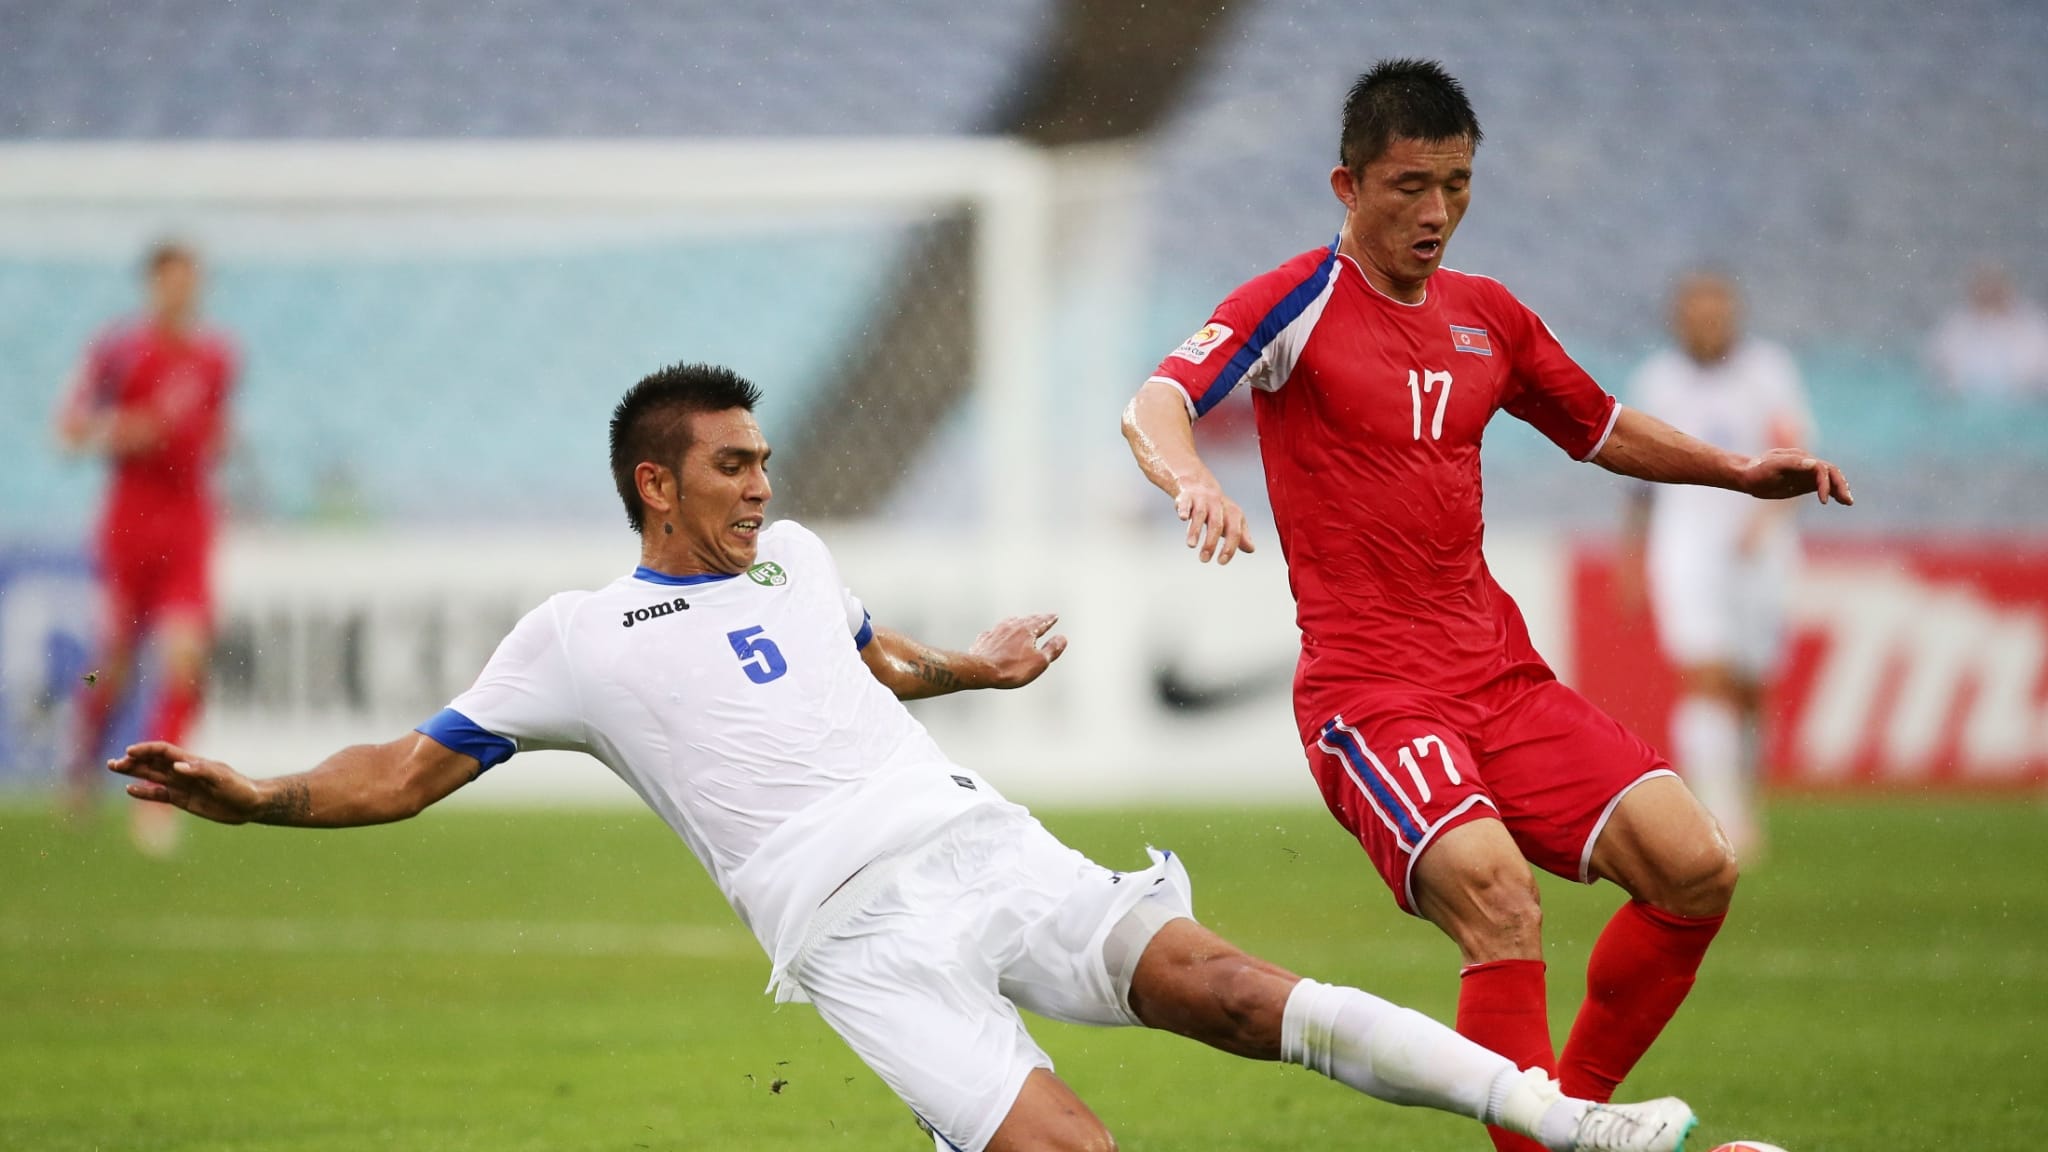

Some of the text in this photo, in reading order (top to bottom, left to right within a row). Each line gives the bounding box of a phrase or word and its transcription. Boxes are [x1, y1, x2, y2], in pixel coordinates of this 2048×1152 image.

[1407, 368, 1453, 441] 17
[751, 563, 777, 582] UFF
[726, 624, 788, 685] 5
[1397, 734, 1462, 804] 17
